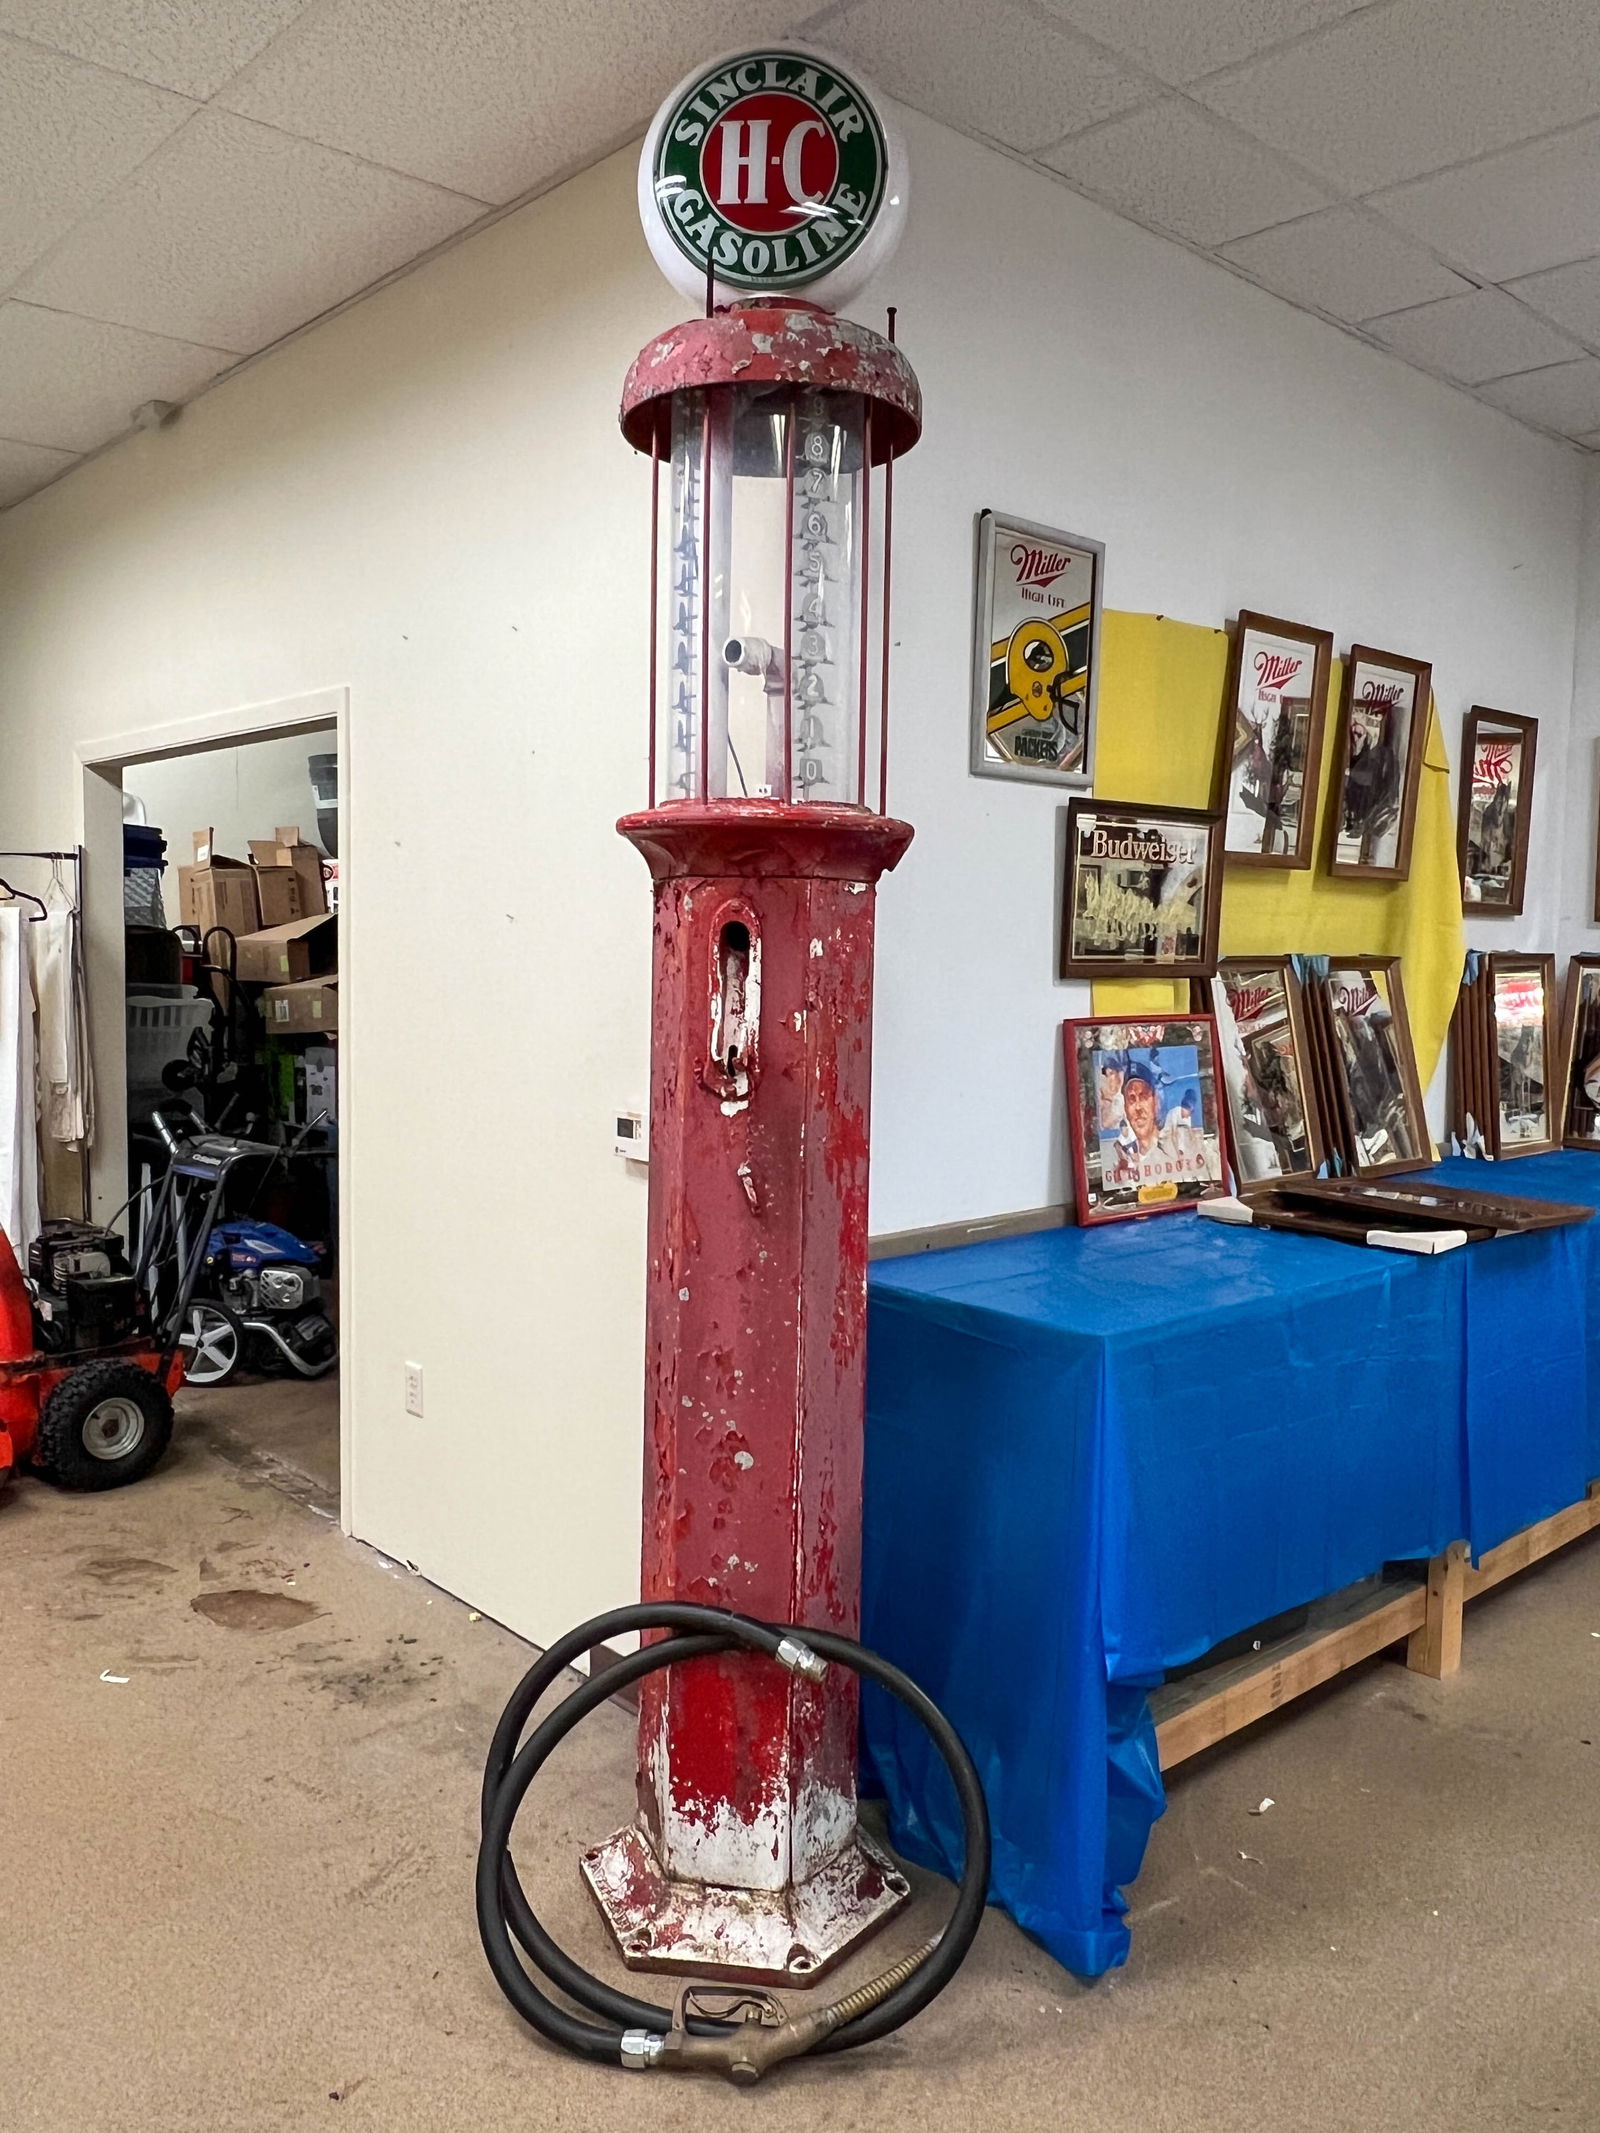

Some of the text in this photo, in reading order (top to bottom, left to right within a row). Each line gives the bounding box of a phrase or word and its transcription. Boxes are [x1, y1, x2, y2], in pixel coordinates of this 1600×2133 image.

[675, 61, 864, 146] SINCLAIR
[674, 183, 866, 274] GASOLINE
[811, 435, 823, 456] 8
[812, 472, 823, 493] 7
[808, 513, 821, 536] 6
[809, 552, 821, 572] 5
[1010, 544, 1071, 582] Miller
[807, 635, 819, 655] 3
[1254, 651, 1302, 686] Miller
[807, 675, 819, 697] 2
[806, 761, 817, 780] 0
[1090, 829, 1197, 865] Budweiser
